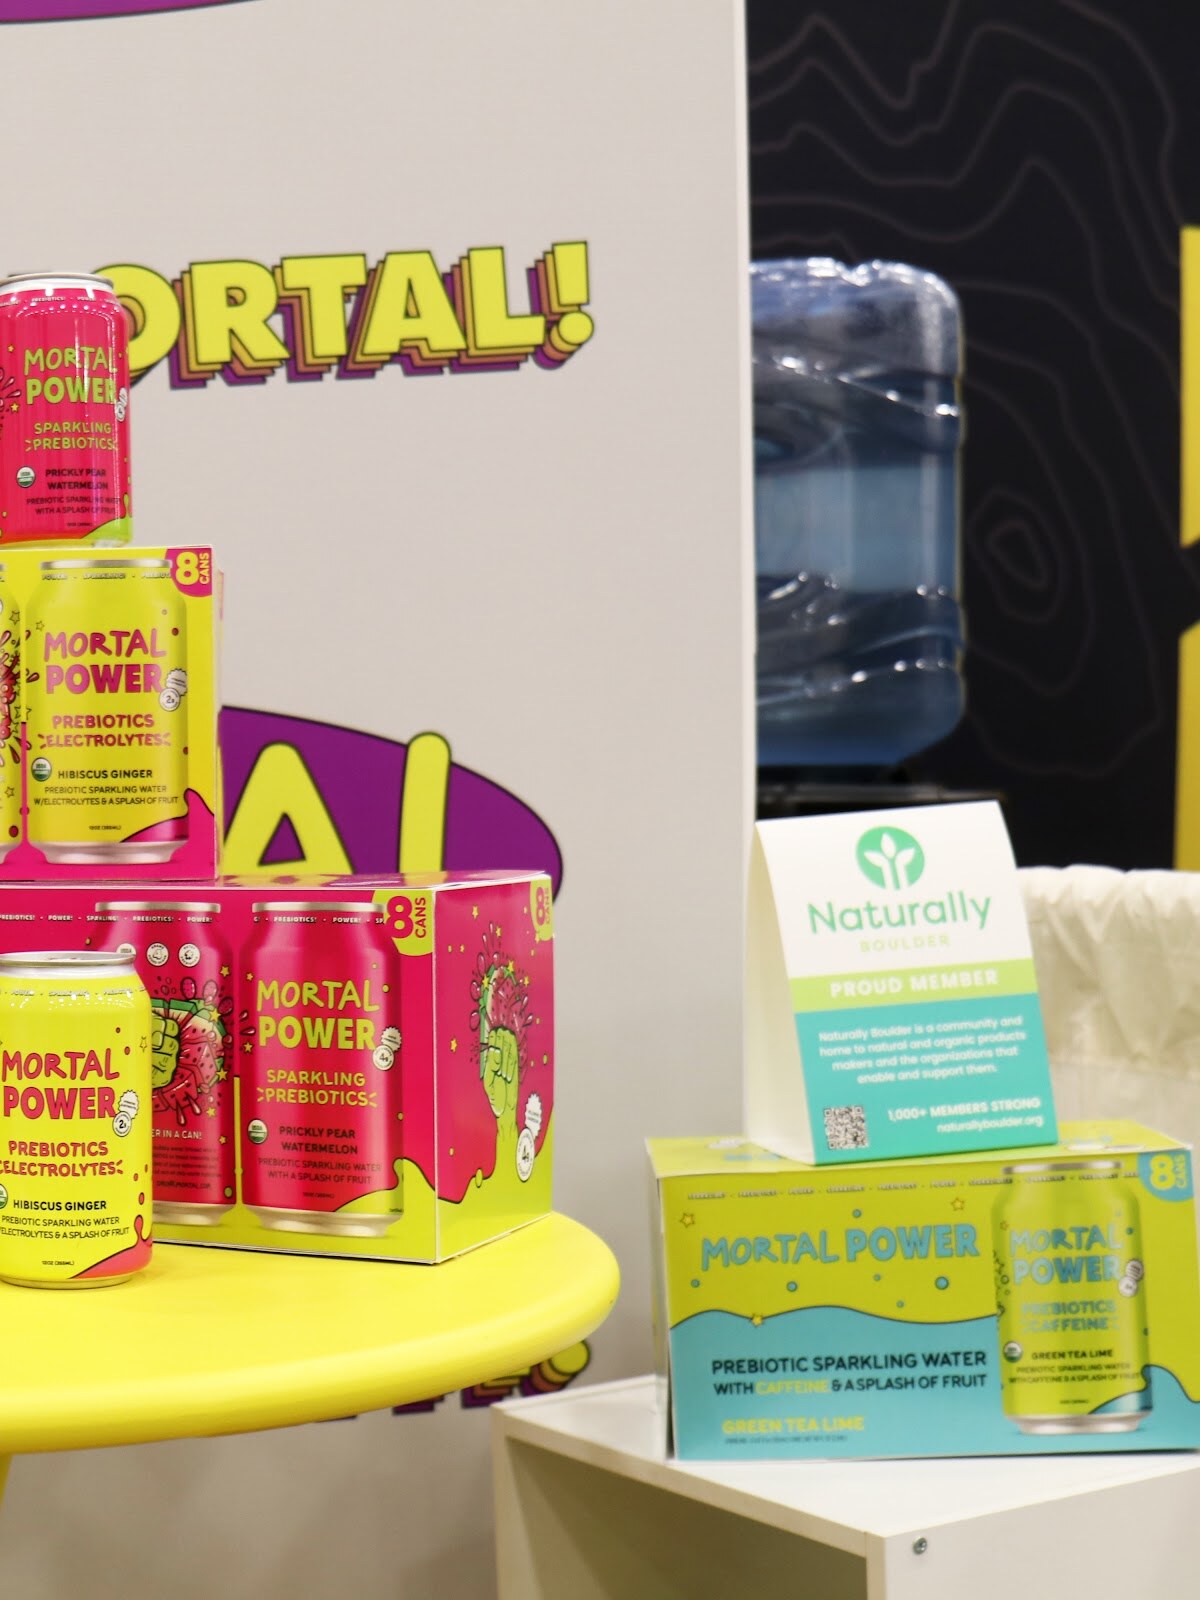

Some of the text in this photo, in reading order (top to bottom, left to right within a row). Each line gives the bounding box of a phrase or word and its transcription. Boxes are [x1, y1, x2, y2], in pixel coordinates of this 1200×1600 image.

[24, 347, 117, 375] MORTAL
[26, 376, 116, 404] POWER
[34, 422, 111, 434] SPARKLING
[33, 437, 114, 450] PREBIOTICS
[45, 469, 83, 477] PRICKLY
[47, 482, 108, 490] WATERMELON
[176, 551, 210, 585] 8 CANS
[44, 628, 166, 662] MORTAL
[46, 663, 165, 695] POWER
[52, 714, 155, 729] PREBIOTICS
[46, 733, 162, 748] ELECTROLYTES
[58, 770, 153, 779] HIBISCUS GINGER
[45, 785, 166, 794] PREBIOTIC SPARKLING WATER
[115, 796, 178, 805] SPLASH FRUIT
[536, 886, 545, 925] 8
[808, 891, 992, 934] Naturally
[385, 895, 426, 938] 8 CANS
[860, 935, 950, 952] BOULDER
[830, 968, 999, 998] PROUD MEMBER
[256, 980, 380, 1012] MORTAL
[258, 1015, 376, 1050] POWER
[819, 1016, 1023, 1042] Naturally Boulder community and
[819, 1030, 1026, 1057] home natural and organic products
[2, 1048, 120, 1082] MORTAL
[832, 1046, 1018, 1071] makers and the organizations that
[267, 1069, 366, 1086] SPARKLING
[857, 1071, 896, 1084] enable
[898, 1069, 920, 1080] and
[922, 1065, 964, 1080] support
[3, 1085, 116, 1119] POWER
[265, 1088, 369, 1107] PREBIOTICS
[930, 1101, 988, 1118] MEMBERS
[991, 1097, 1041, 1112] STRONG
[279, 1126, 355, 1139] PRICKLY PEAR
[8, 1141, 108, 1157] PREBIOTICS
[282, 1142, 358, 1154] WATERMELON
[3, 1161, 116, 1177] ELECTROLYTES
[258, 1158, 381, 1171] PREBIOTIC SPARKLING WATER
[1150, 1154, 1177, 1191] 8
[13, 1200, 107, 1210] HIBISCUS GINGER
[2, 1216, 120, 1227] PREBIOTIC SPARKLING WATER
[69, 1227, 129, 1238] SPLASH FRUIT
[1010, 1225, 1123, 1256] MORTAL
[701, 1223, 980, 1272] MORTAL POWER
[1013, 1255, 1122, 1285] POWER
[1022, 1300, 1116, 1315] PREBIOTICS
[712, 1351, 986, 1375] PREBIOTIC SPARKLING WATER
[1032, 1350, 1113, 1360] GREEN TEA LIME
[713, 1382, 754, 1395] WITH
[832, 1379, 842, 1392] &
[844, 1380, 858, 1391] A
[858, 1377, 915, 1391] SPLASH
[918, 1376, 939, 1389] OF
[942, 1374, 987, 1388] FRUIT
[722, 1416, 864, 1435] GREEN TEA LIME
